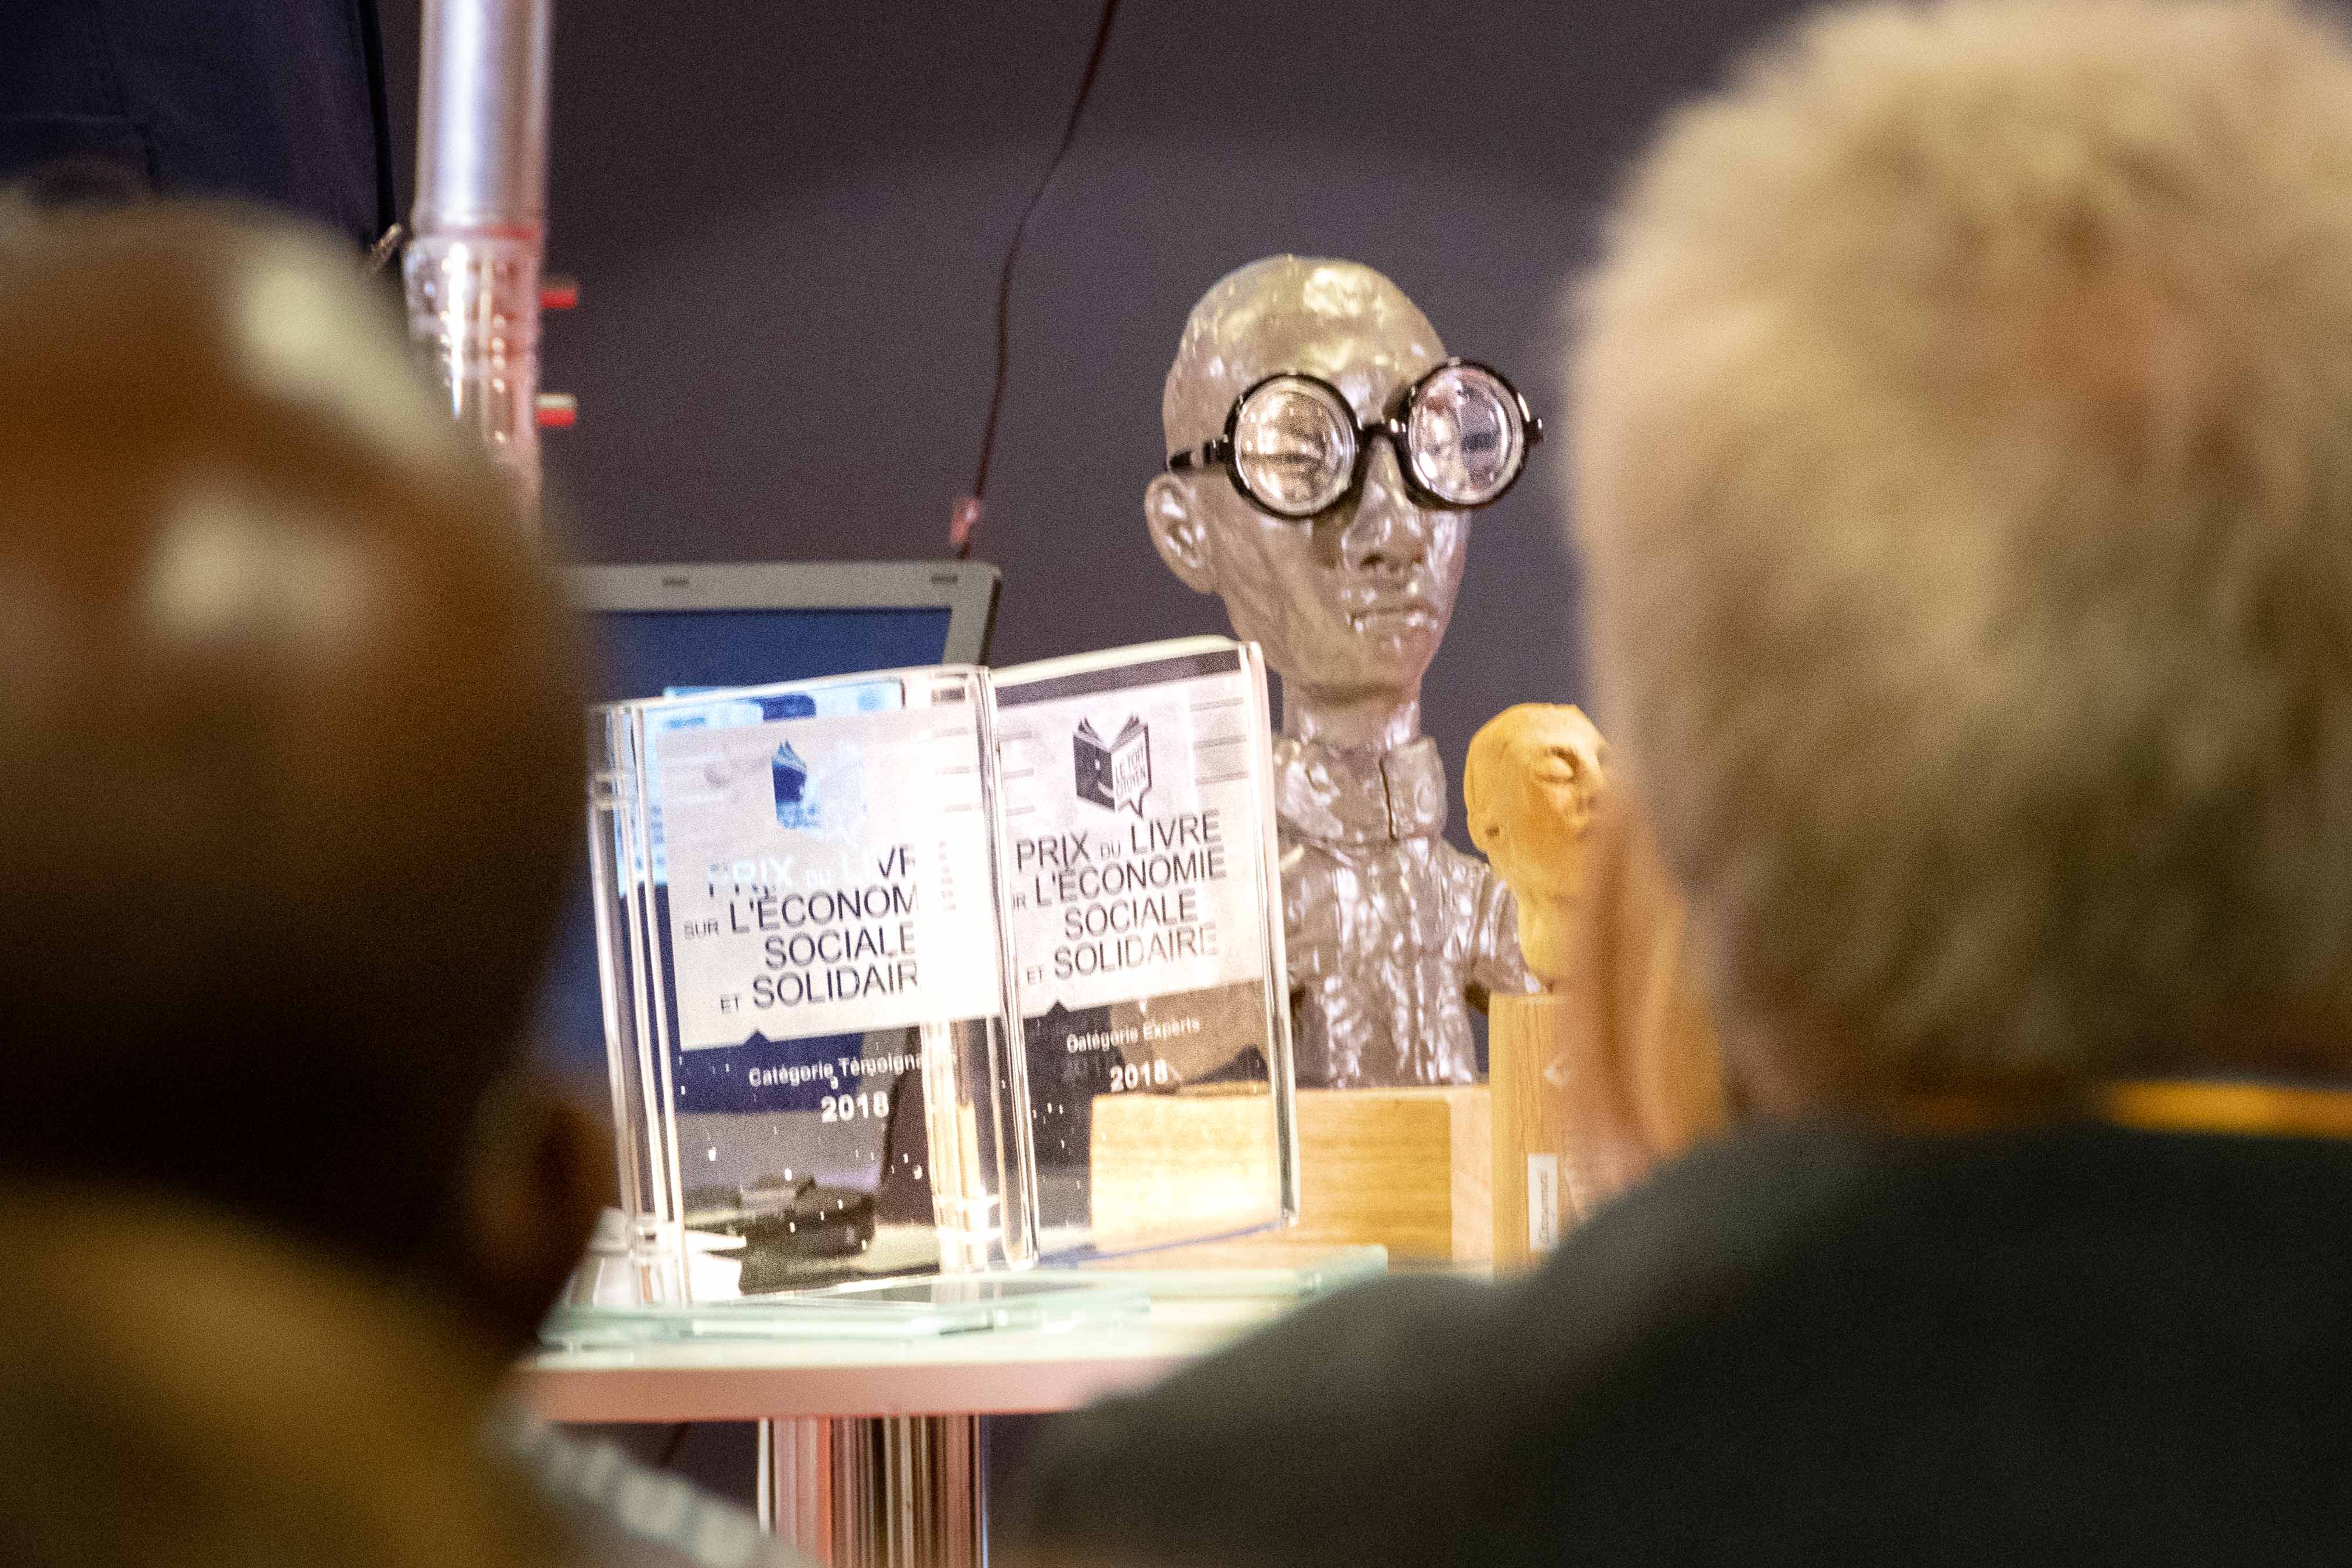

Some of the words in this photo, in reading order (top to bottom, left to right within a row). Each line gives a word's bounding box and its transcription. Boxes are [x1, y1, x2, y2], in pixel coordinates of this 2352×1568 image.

[1016, 831, 1091, 873] PRIX
[1100, 840, 1121, 861] DU
[1131, 808, 1221, 855] LIVRE
[683, 918, 719, 940] SUR
[1065, 889, 1197, 941] SOCIALE
[765, 921, 917, 970] SOCIALE
[1026, 965, 1043, 986] ET
[1054, 921, 1217, 980] SOLIDAIRE
[720, 993, 740, 1015] ET
[753, 959, 918, 1010] SOLIDAIR
[749, 1060, 834, 1087] Catégorie
[1110, 1058, 1168, 1093] 2018
[821, 1090, 889, 1124] 2018
